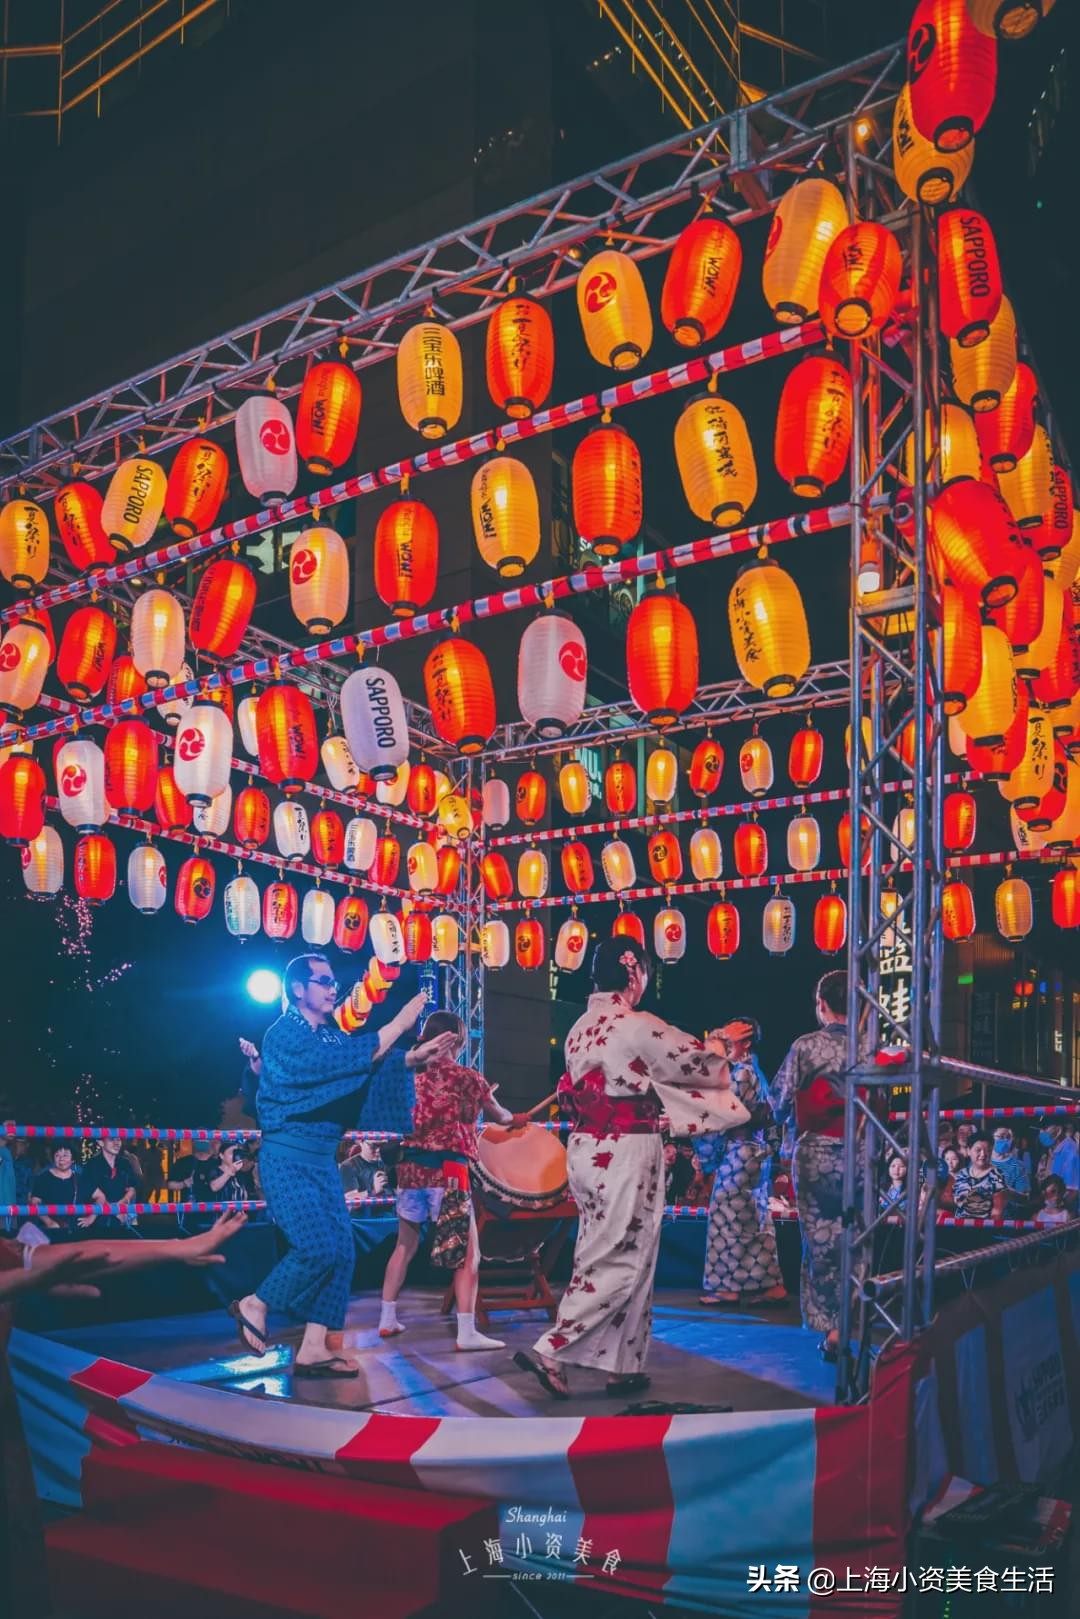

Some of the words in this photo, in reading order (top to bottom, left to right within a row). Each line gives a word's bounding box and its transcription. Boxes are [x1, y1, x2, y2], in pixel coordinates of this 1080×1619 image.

[702, 257, 722, 298] WOW!
[960, 216, 991, 299] SAPPORO
[422, 327, 446, 396] 三宝乐啤酒
[123, 465, 153, 525] SAPPORO
[479, 501, 497, 540] WOW!
[397, 539, 413, 580] WOW!
[366, 677, 397, 749] SAPPORO
[1028, 716, 1048, 781] 夏祭り
